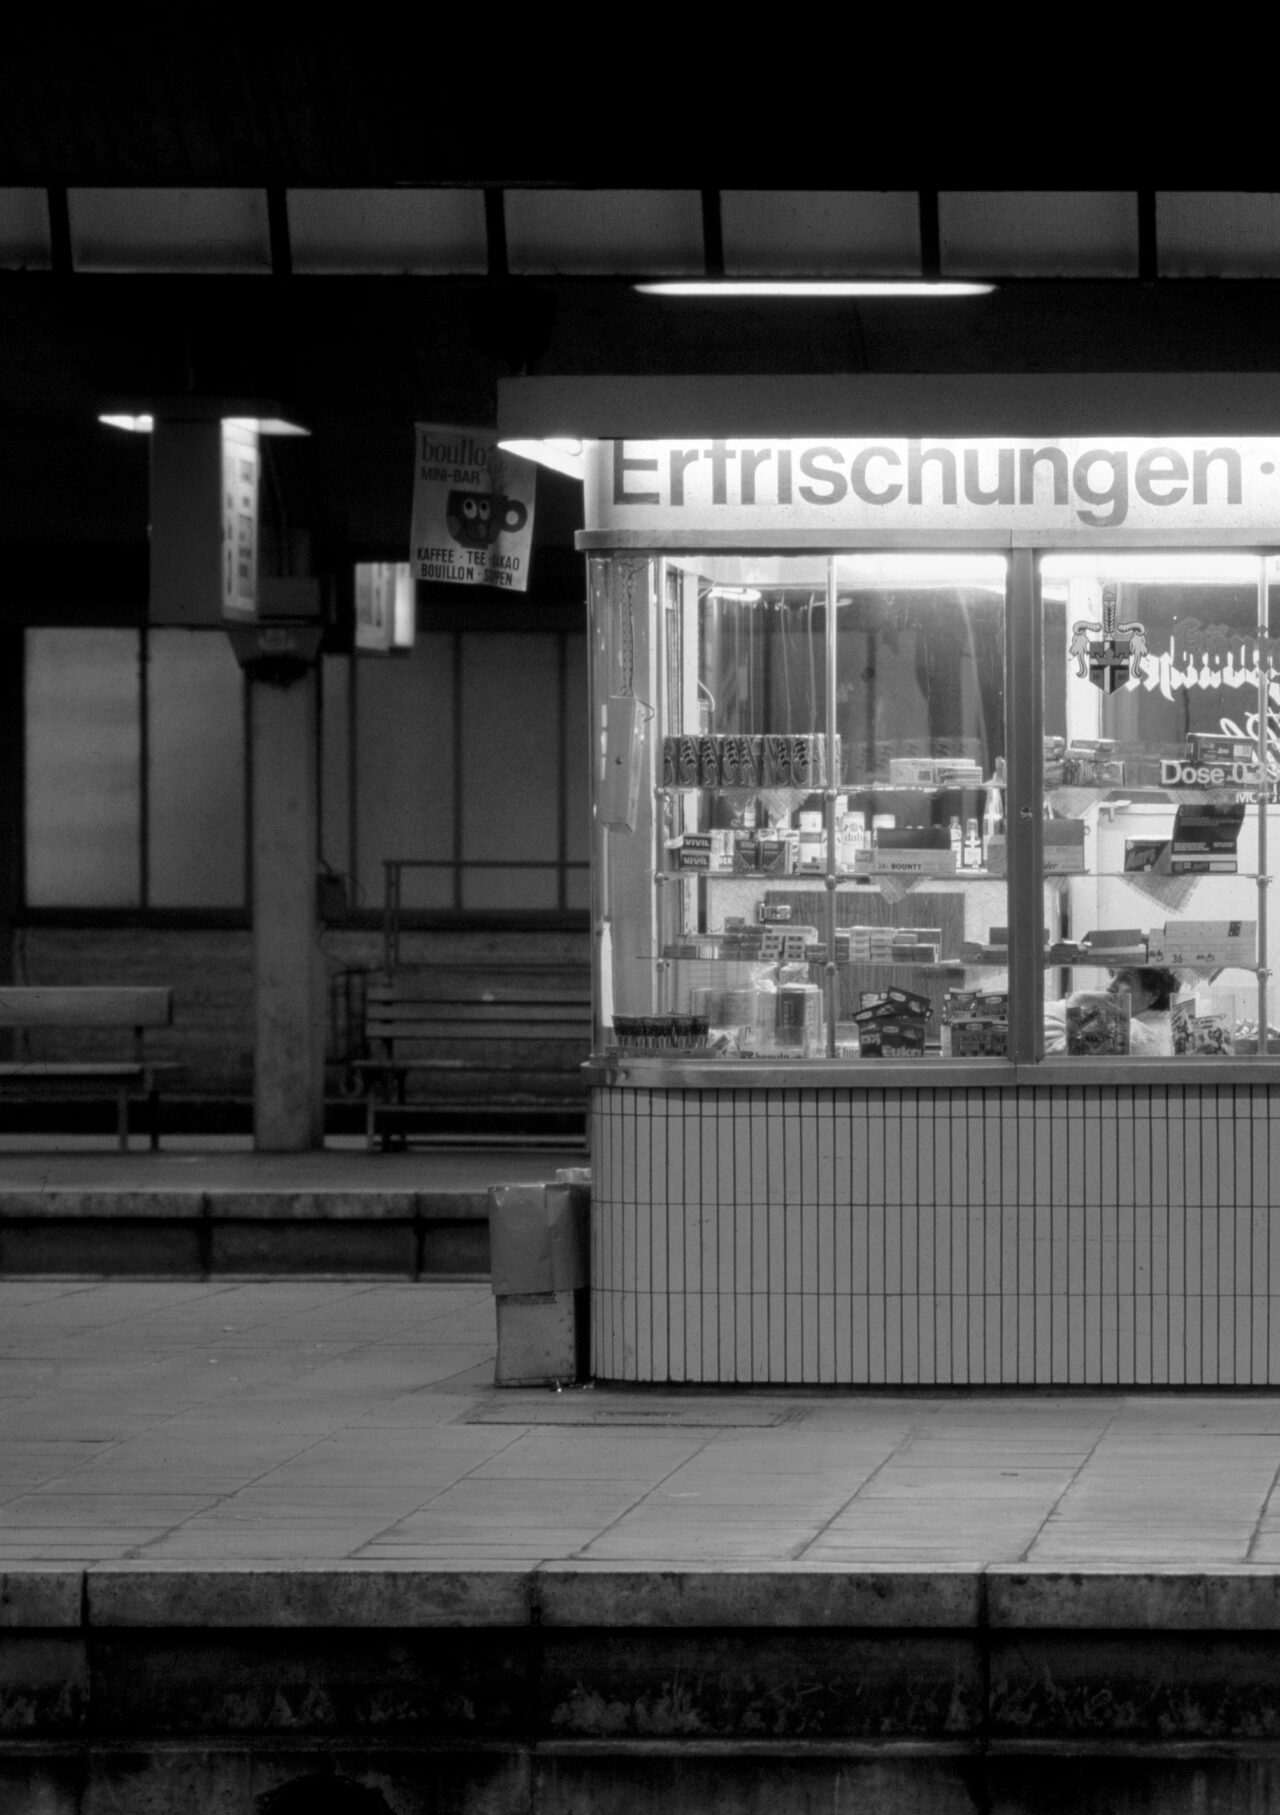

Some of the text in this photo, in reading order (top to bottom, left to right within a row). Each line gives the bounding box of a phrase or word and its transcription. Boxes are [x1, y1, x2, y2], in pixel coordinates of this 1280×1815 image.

[421, 466, 481, 485] MINI-BAR
[417, 545, 455, 564] KAFFEE
[466, 550, 487, 566] TEE
[421, 563, 474, 581] BOUILLON
[1160, 761, 1225, 785] Dose
